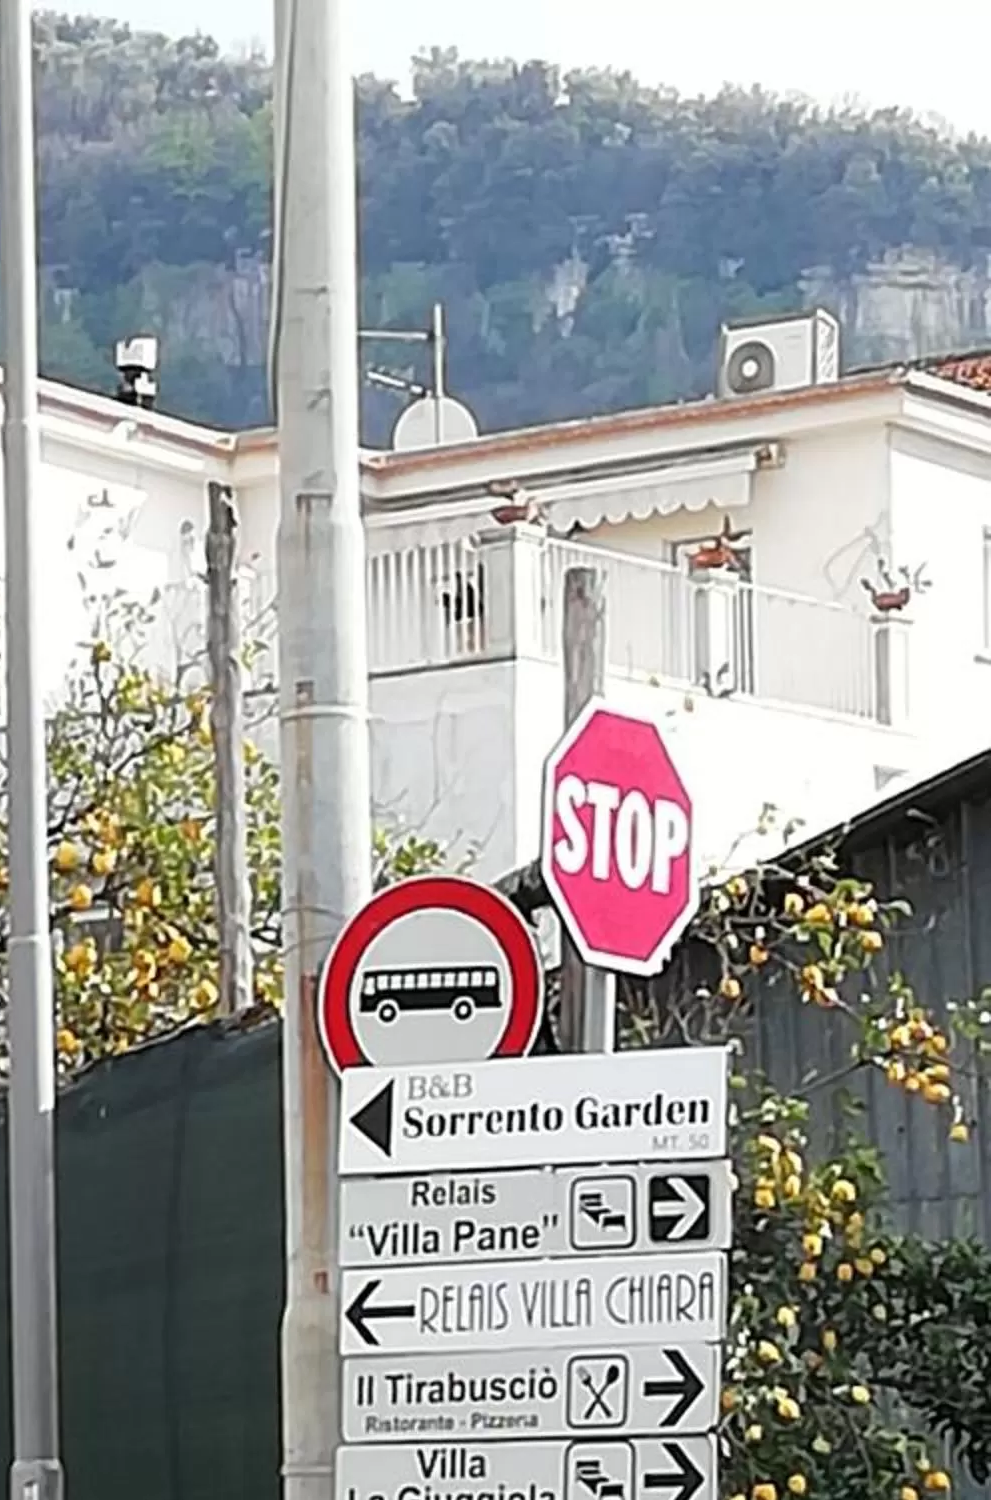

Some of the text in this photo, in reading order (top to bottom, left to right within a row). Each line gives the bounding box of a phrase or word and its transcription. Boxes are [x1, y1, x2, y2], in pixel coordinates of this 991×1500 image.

[553, 773, 689, 895] STOP
[407, 1074, 473, 1100] B&B
[402, 1094, 709, 1139] Sorrento Garden
[411, 1179, 496, 1207] Relais
[420, 1272, 714, 1334] RELAIS VILLA CHIARA
[356, 1367, 558, 1406] Il Tirabusciò
[365, 1415, 455, 1434] Ristorante
[471, 1412, 538, 1430] Pizzeria
[416, 1449, 486, 1480] Villa
